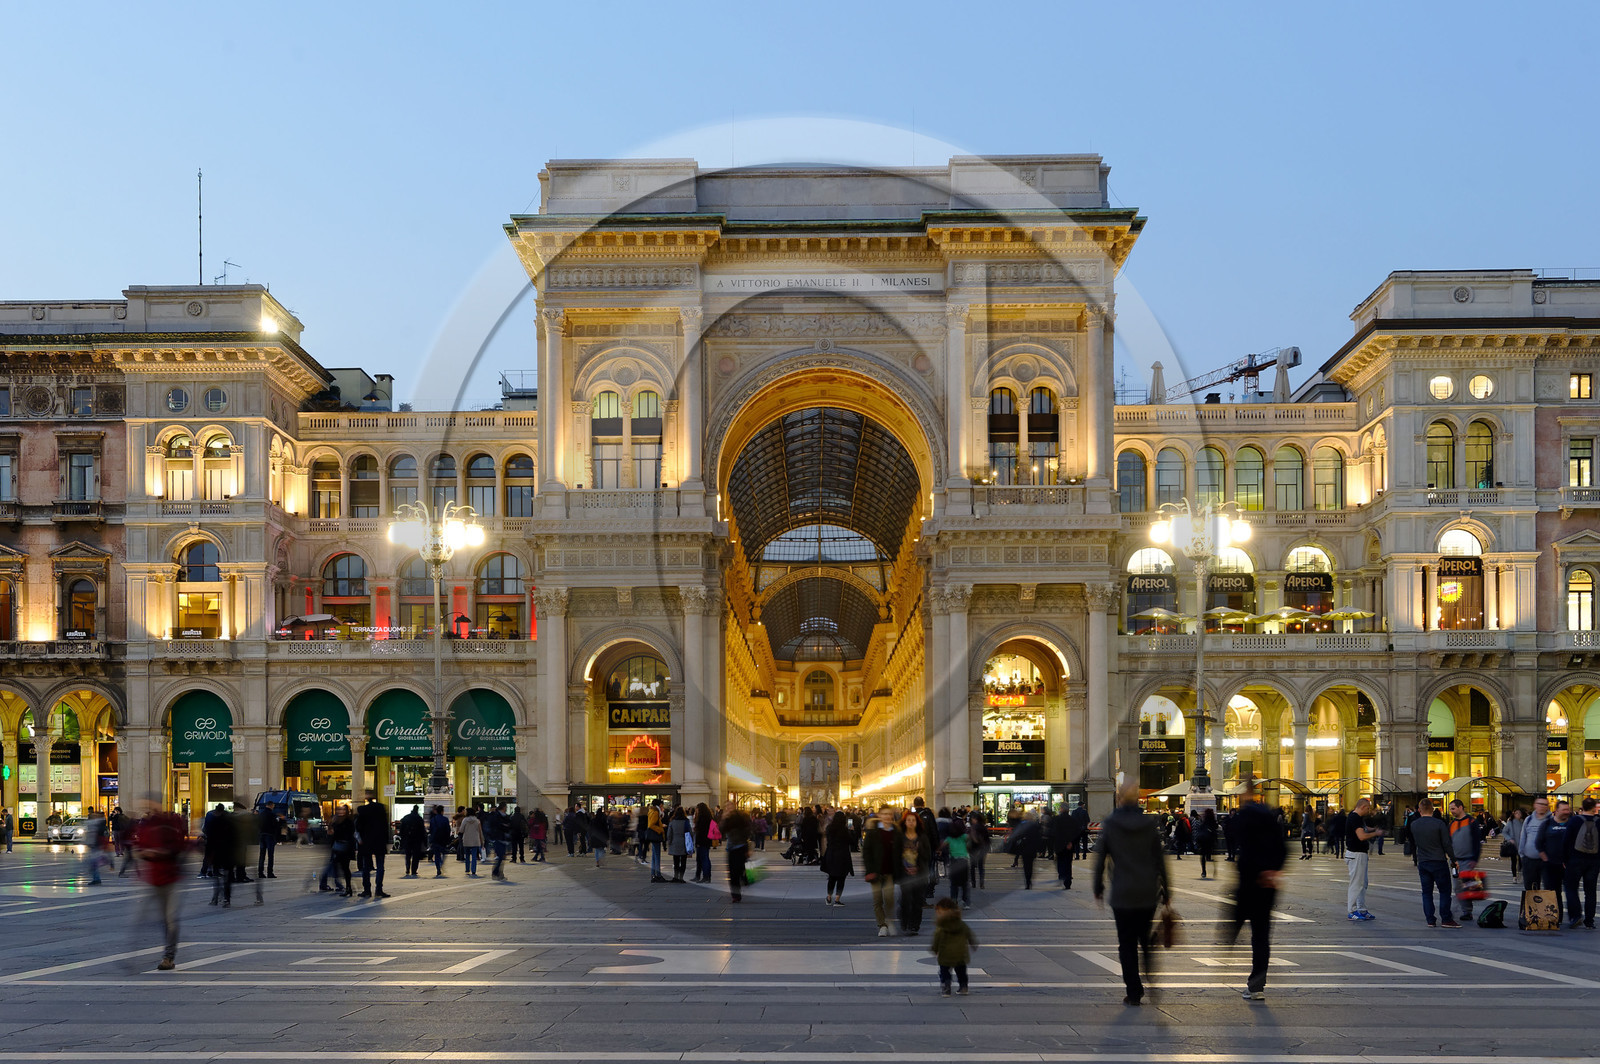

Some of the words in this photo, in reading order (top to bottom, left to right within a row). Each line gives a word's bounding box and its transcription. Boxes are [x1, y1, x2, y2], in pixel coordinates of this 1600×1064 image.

[717, 279, 724, 288] A
[730, 278, 781, 288] VITTORIO
[787, 278, 846, 288] EMANUELE
[880, 277, 931, 287] MILANESI
[1439, 558, 1477, 571] APEROL
[1131, 576, 1170, 589] APEROL
[1208, 575, 1248, 588] APEROL
[1286, 575, 1326, 587] APEROL
[989, 695, 1025, 706] Kartell
[375, 718, 428, 740] Currado
[457, 718, 510, 740] Currado
[184, 730, 227, 740] GRIMOLDI
[298, 732, 343, 742] GRIMOLDI
[997, 741, 1022, 750] Motta
[1141, 740, 1167, 749] Motta
